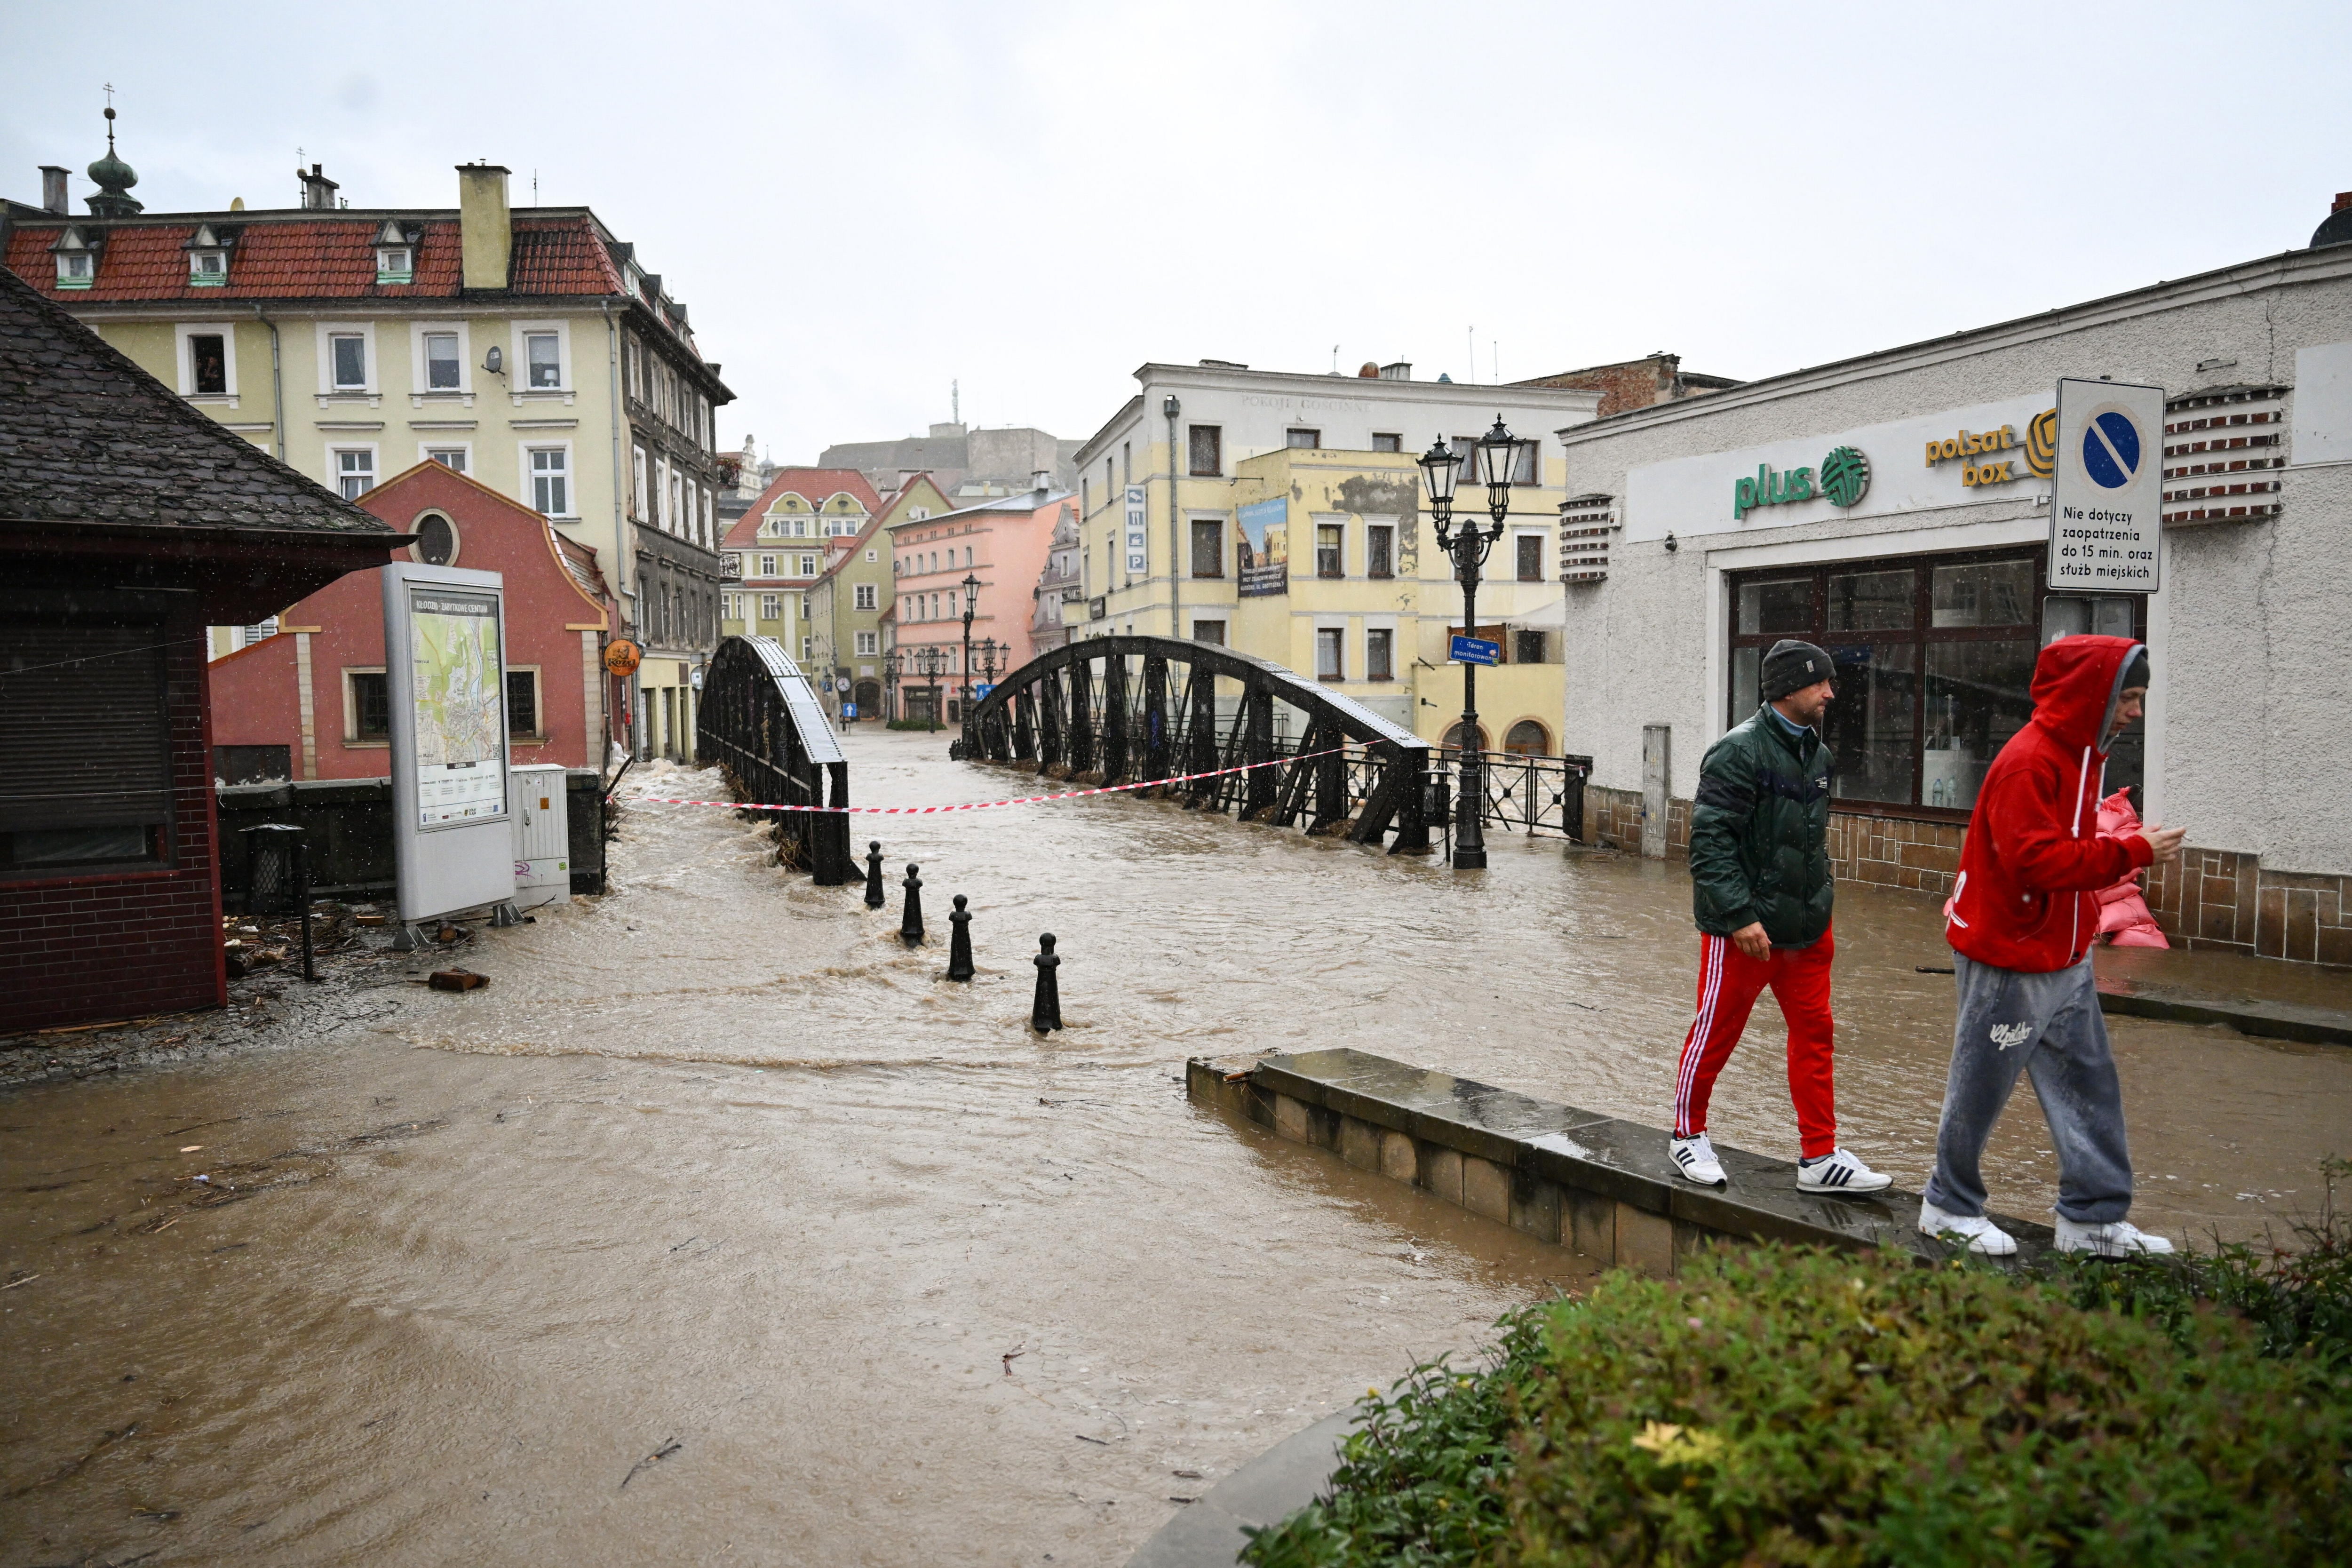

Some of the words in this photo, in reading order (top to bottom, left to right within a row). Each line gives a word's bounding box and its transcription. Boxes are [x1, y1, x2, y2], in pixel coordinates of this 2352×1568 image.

[1925, 424, 2013, 468] polsat
[1962, 461, 2014, 487] box
[1734, 463, 1813, 520] plus
[2064, 506, 2083, 519] Nie
[2089, 508, 2132, 525] dotyczy
[2062, 527, 2139, 542] zaopatrzenia
[2061, 544, 2077, 557] do
[2082, 545, 2094, 557] 15
[2099, 546, 2122, 558] min.
[2128, 550, 2153, 560] oraz
[2060, 563, 2091, 575] służb
[2097, 564, 2149, 580] miejskich
[441, 602, 468, 613] ZABYTKOWE
